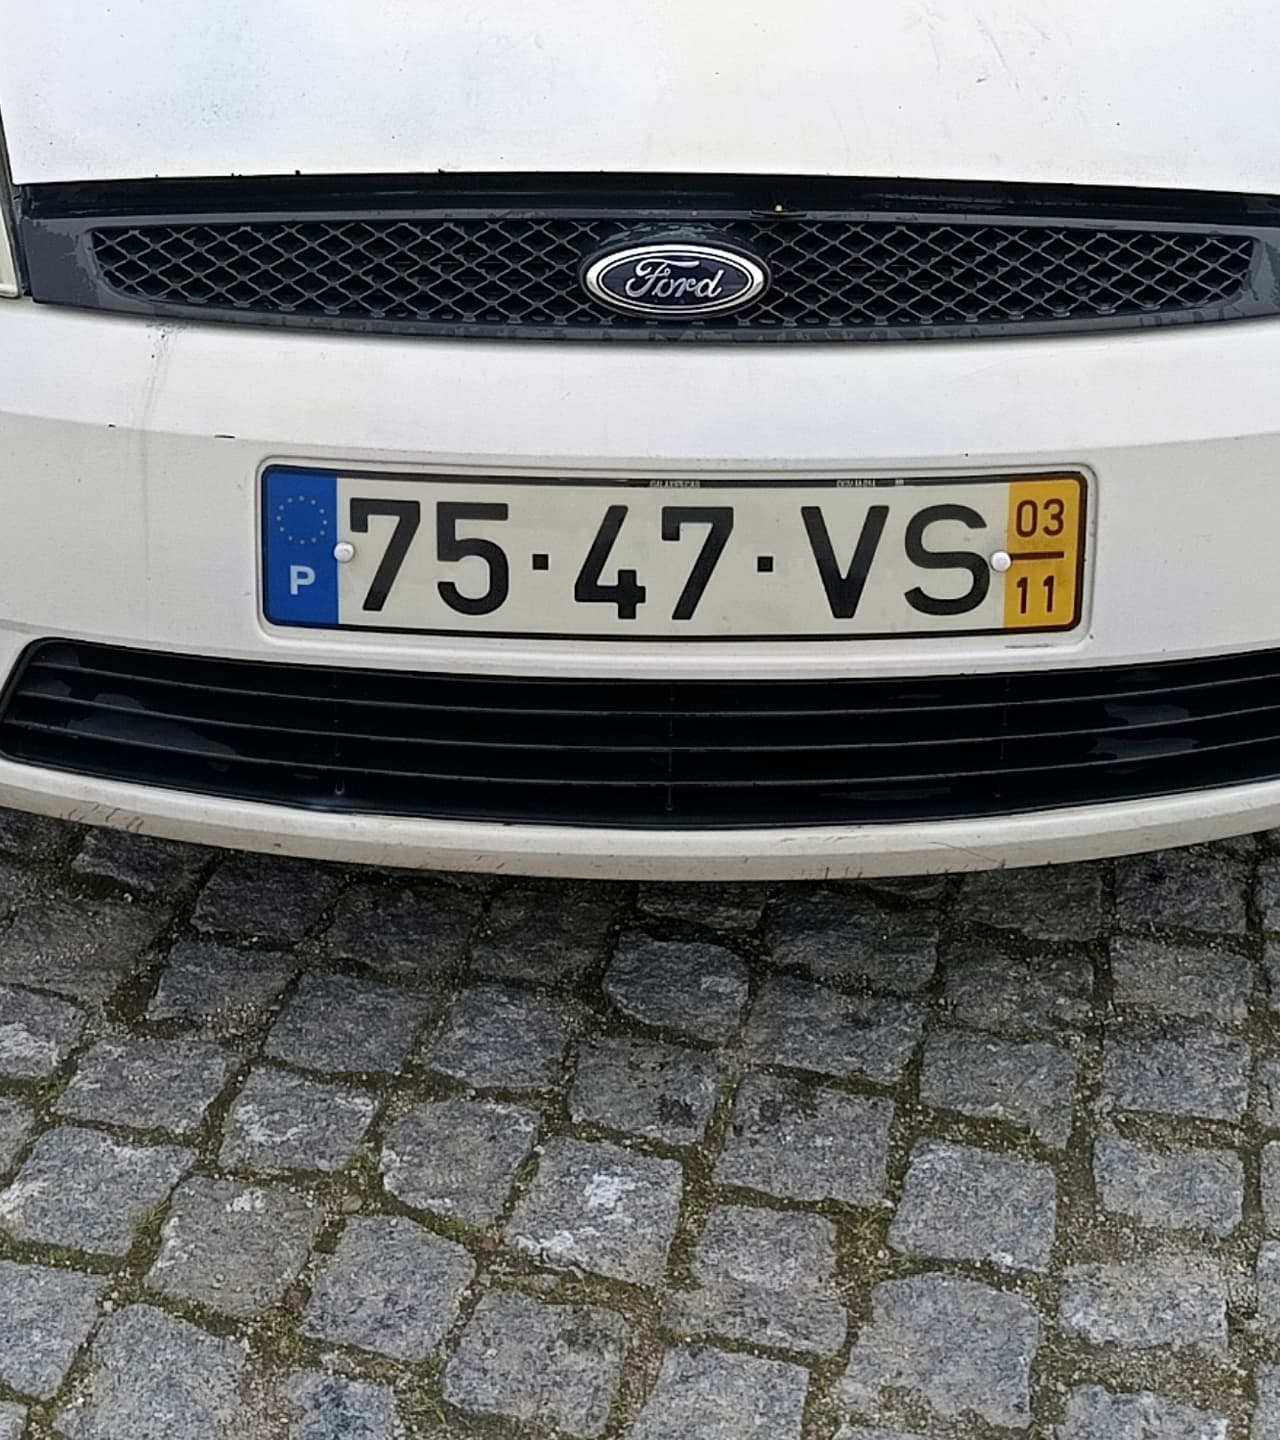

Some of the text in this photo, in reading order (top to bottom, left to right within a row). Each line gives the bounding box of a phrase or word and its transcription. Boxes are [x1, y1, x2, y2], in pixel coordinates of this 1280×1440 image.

[625, 259, 724, 298] Ford
[1016, 498, 1065, 538] 03
[290, 565, 316, 595] P
[1016, 575, 1055, 614] 11
